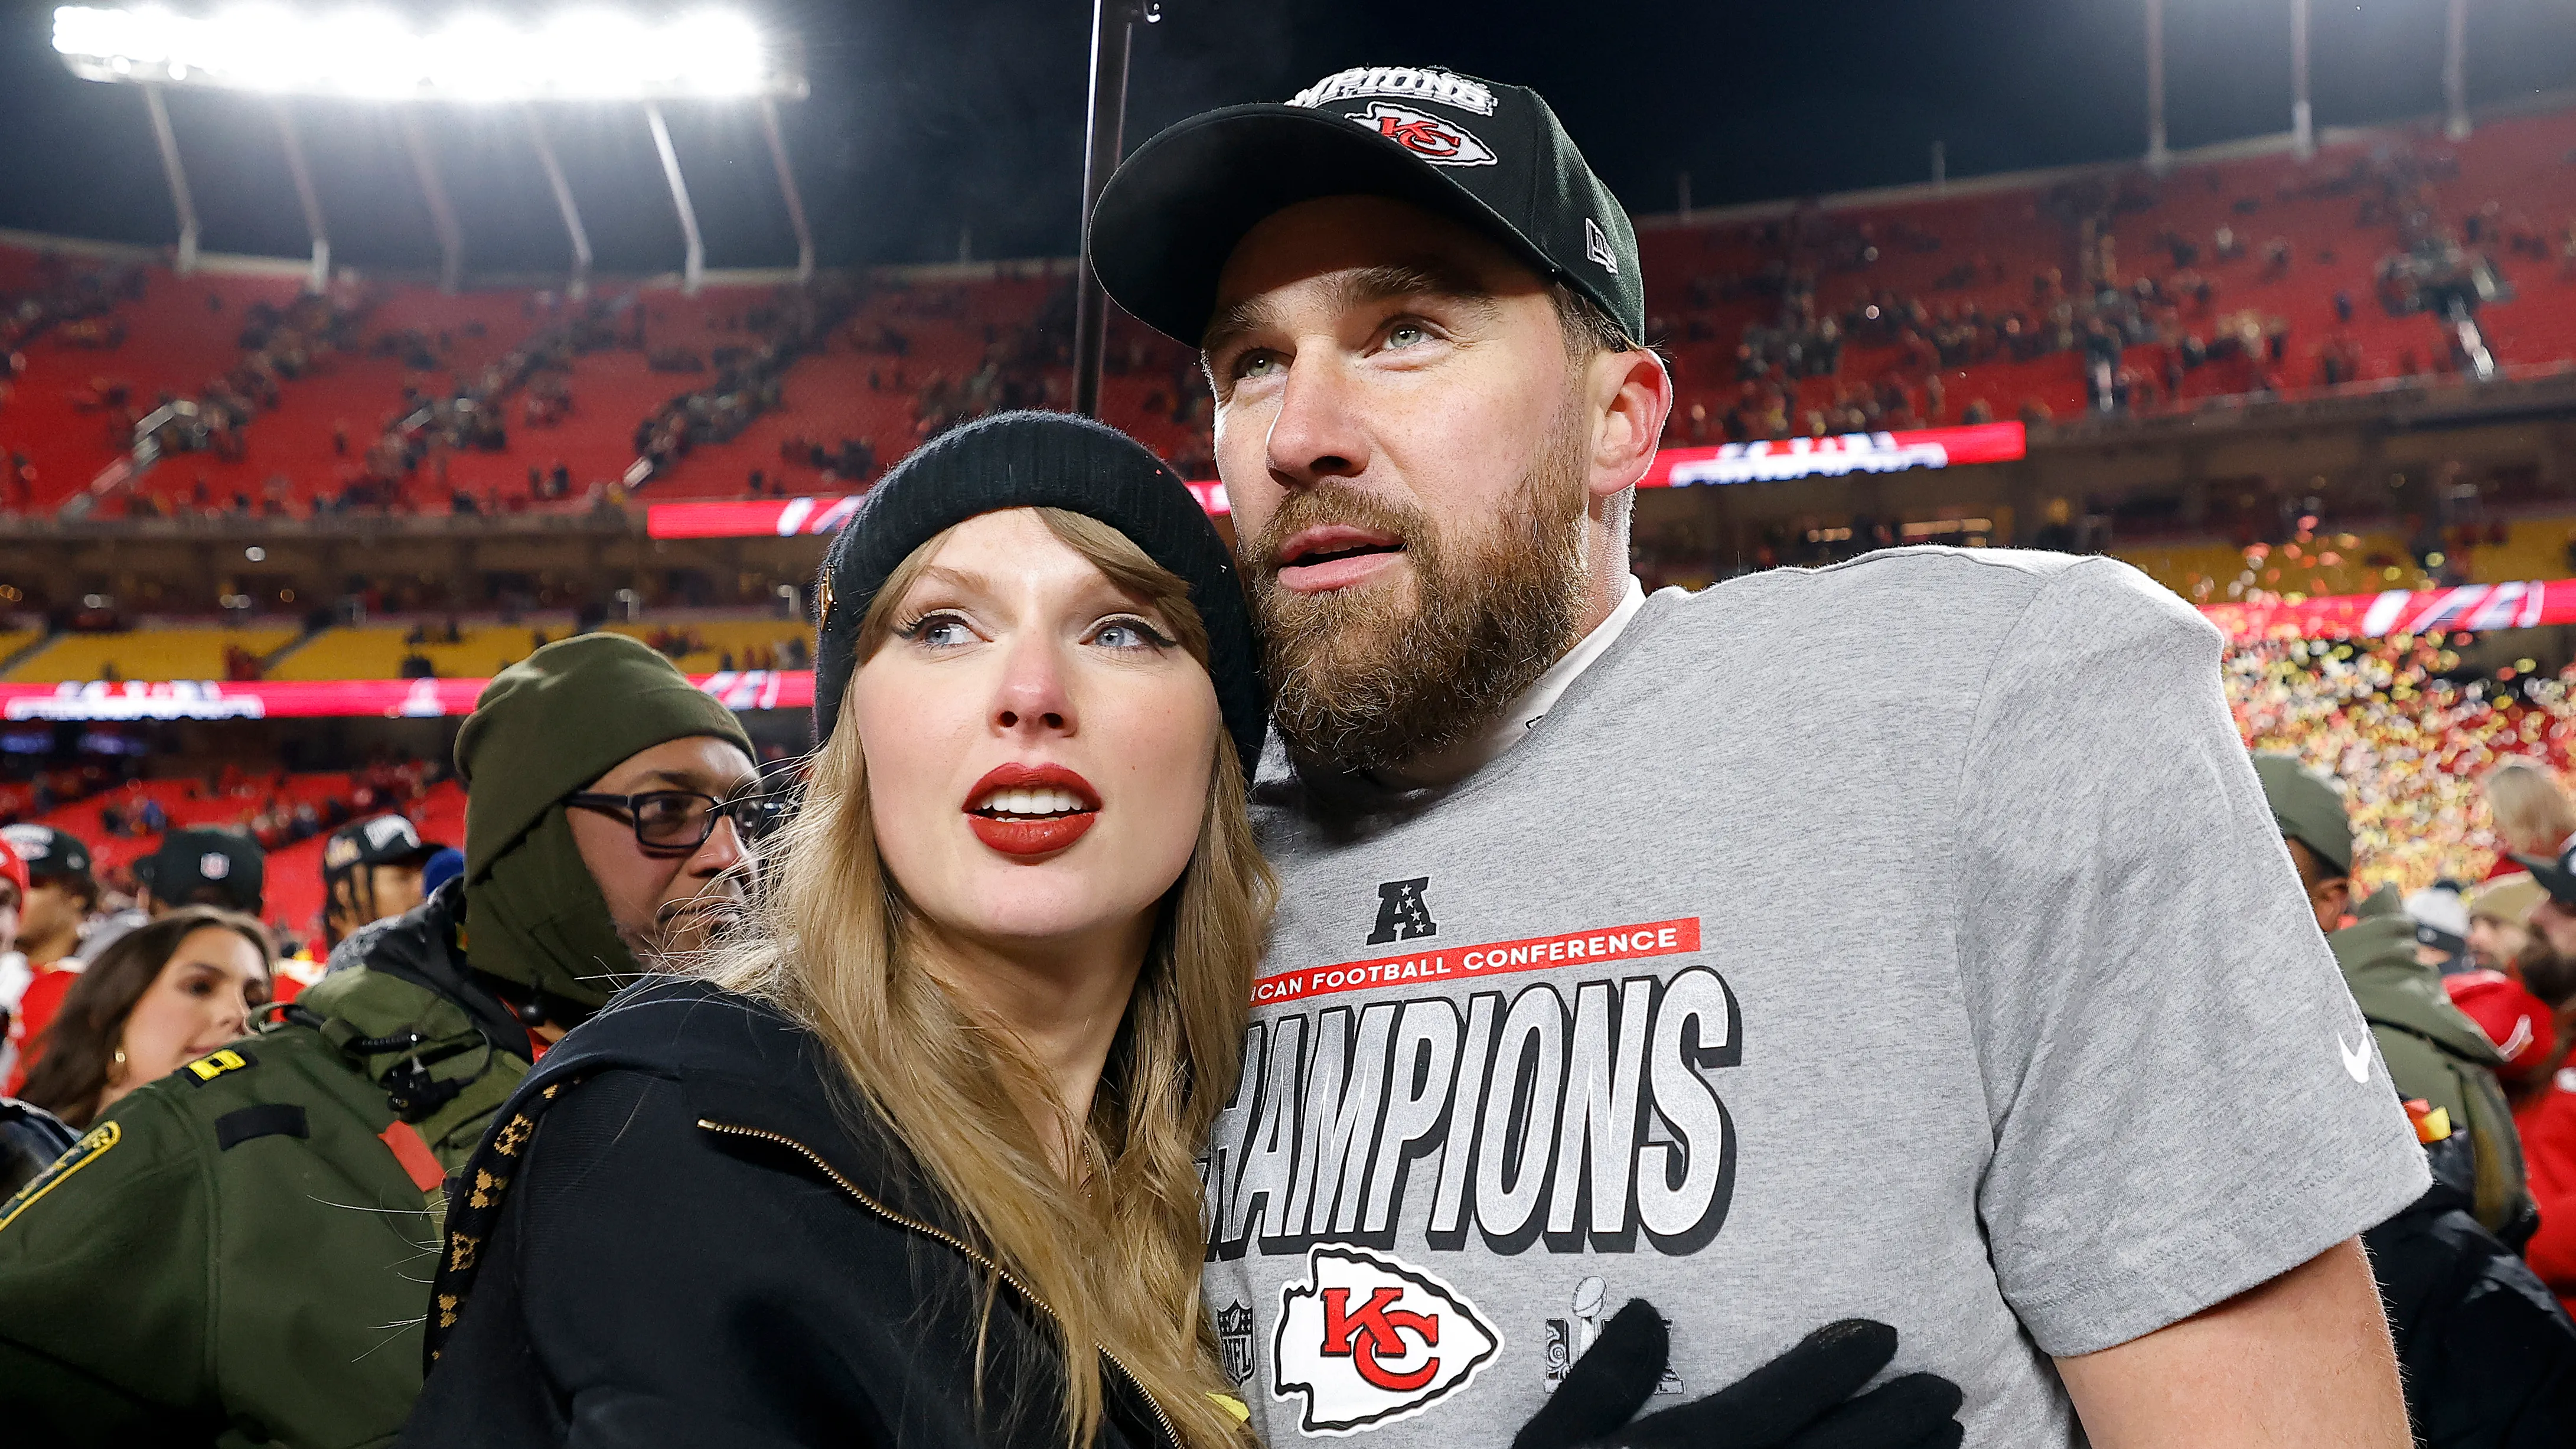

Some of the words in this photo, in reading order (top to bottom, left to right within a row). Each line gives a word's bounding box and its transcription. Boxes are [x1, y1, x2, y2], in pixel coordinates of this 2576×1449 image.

[1380, 117, 1461, 156] KC
[1365, 876, 1437, 945] A
[1250, 977, 1302, 1003] ICAN
[1312, 957, 1451, 991] FOOTBALL
[1462, 927, 1678, 970] CONFERENCE
[1195, 965, 1742, 1257] HAMPIONS
[1222, 1337, 1253, 1379] NFL
[1320, 1287, 1440, 1392] KC
